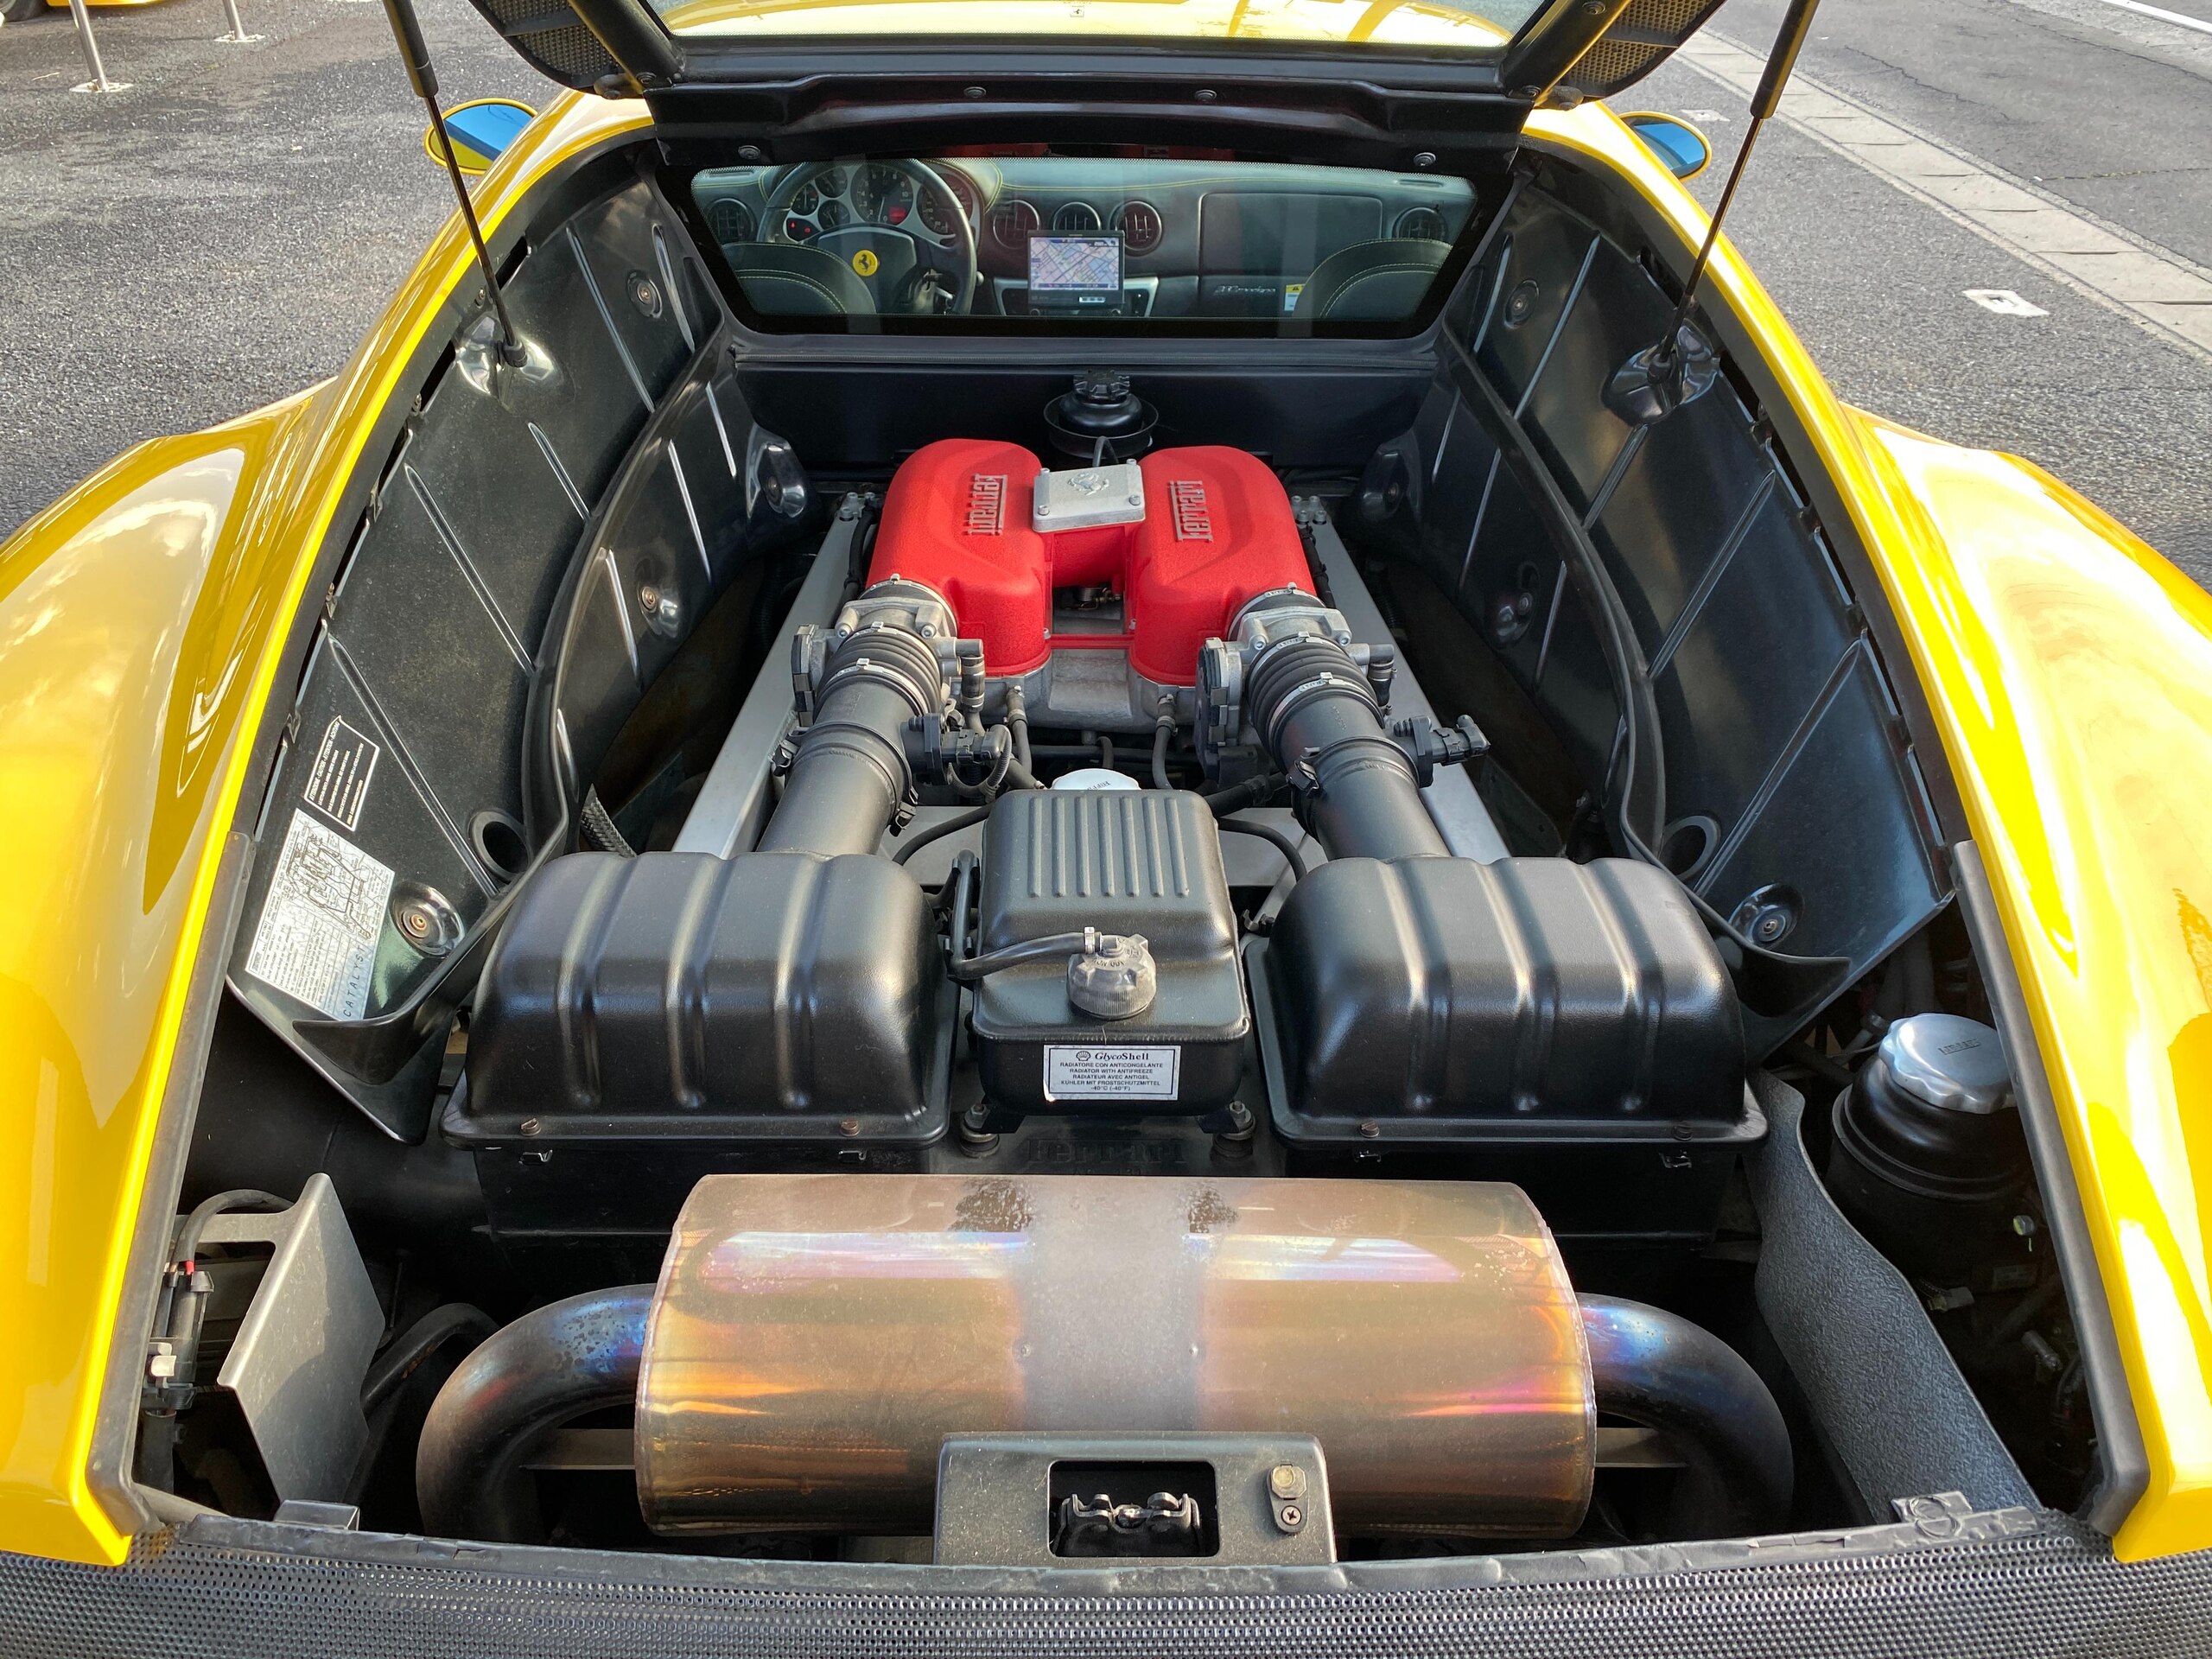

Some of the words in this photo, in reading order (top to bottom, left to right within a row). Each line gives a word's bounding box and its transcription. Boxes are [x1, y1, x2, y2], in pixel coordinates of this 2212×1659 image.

[968, 474, 1008, 535] Ferrari
[1168, 480, 1214, 542] Ferrari
[343, 944, 365, 1017] CATALYST
[1095, 1052, 1149, 1061] GlycoShell
